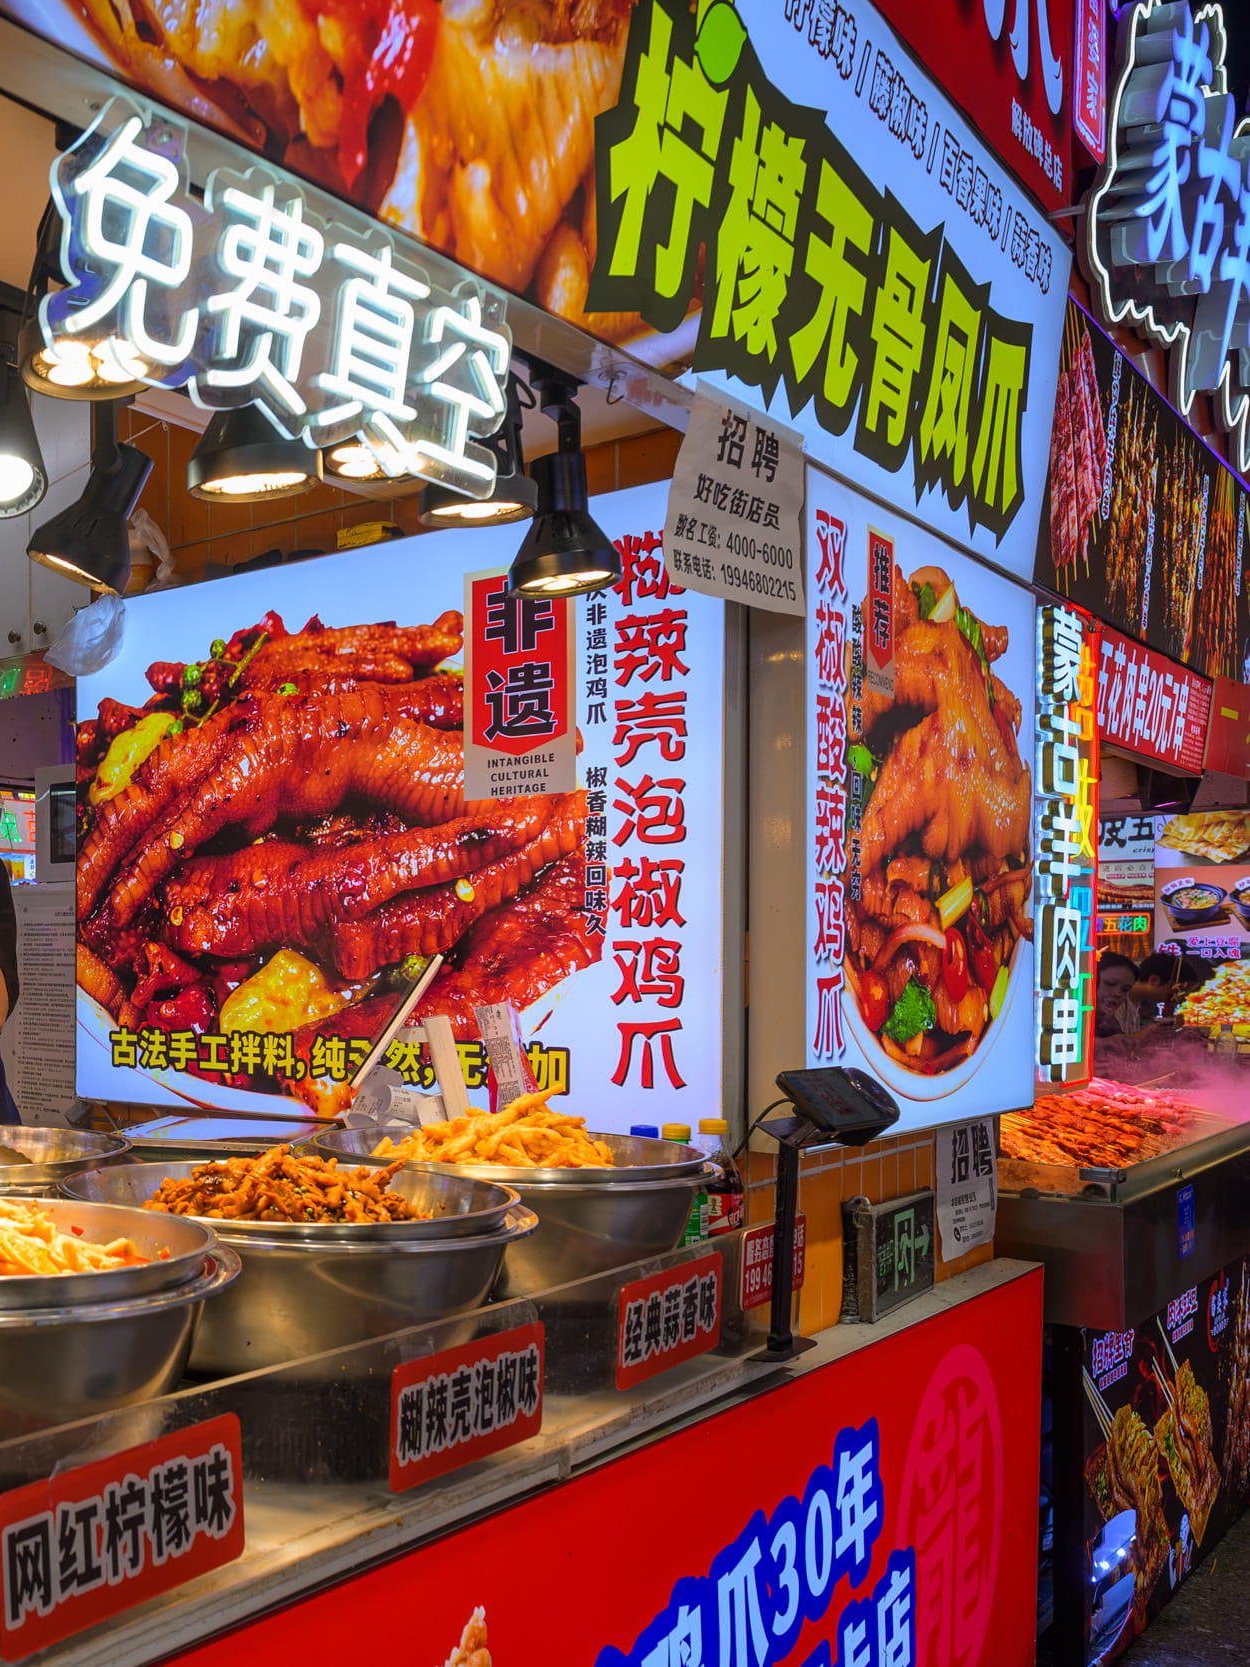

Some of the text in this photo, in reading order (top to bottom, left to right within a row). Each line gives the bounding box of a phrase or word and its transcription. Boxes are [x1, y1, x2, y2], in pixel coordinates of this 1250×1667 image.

[940, 129, 1002, 240] 百香果味
[1010, 212, 1052, 294] 蒜香味
[64, 116, 510, 480] 免费真空
[608, 0, 1026, 515] 柠檬无骨凤爪
[717, 409, 780, 483] 招聘
[693, 473, 781, 531] 好吃街店员
[720, 564, 796, 601] 19946802215
[726, 532, 793, 570] 4000-6000
[874, 543, 891, 649] 推荐
[485, 581, 557, 742] 非遗
[487, 753, 555, 768] INTANGIBLE
[490, 769, 549, 782] CULTURAL
[491, 783, 546, 796] HERITAGE
[814, 508, 847, 1058] 双椒酸辣鸡爪
[586, 767, 607, 936] 椒香糊辣回味久
[1049, 605, 1082, 1081] 蒙古羊肉串
[1187, 948, 1241, 958] 一口入魂
[111, 1030, 567, 1093] 古法手工拌料,纯然,无加
[951, 1123, 993, 1184] 招聘
[622, 1272, 718, 1367] 经典蒜香味
[6, 1450, 235, 1622] 网红柠檬味
